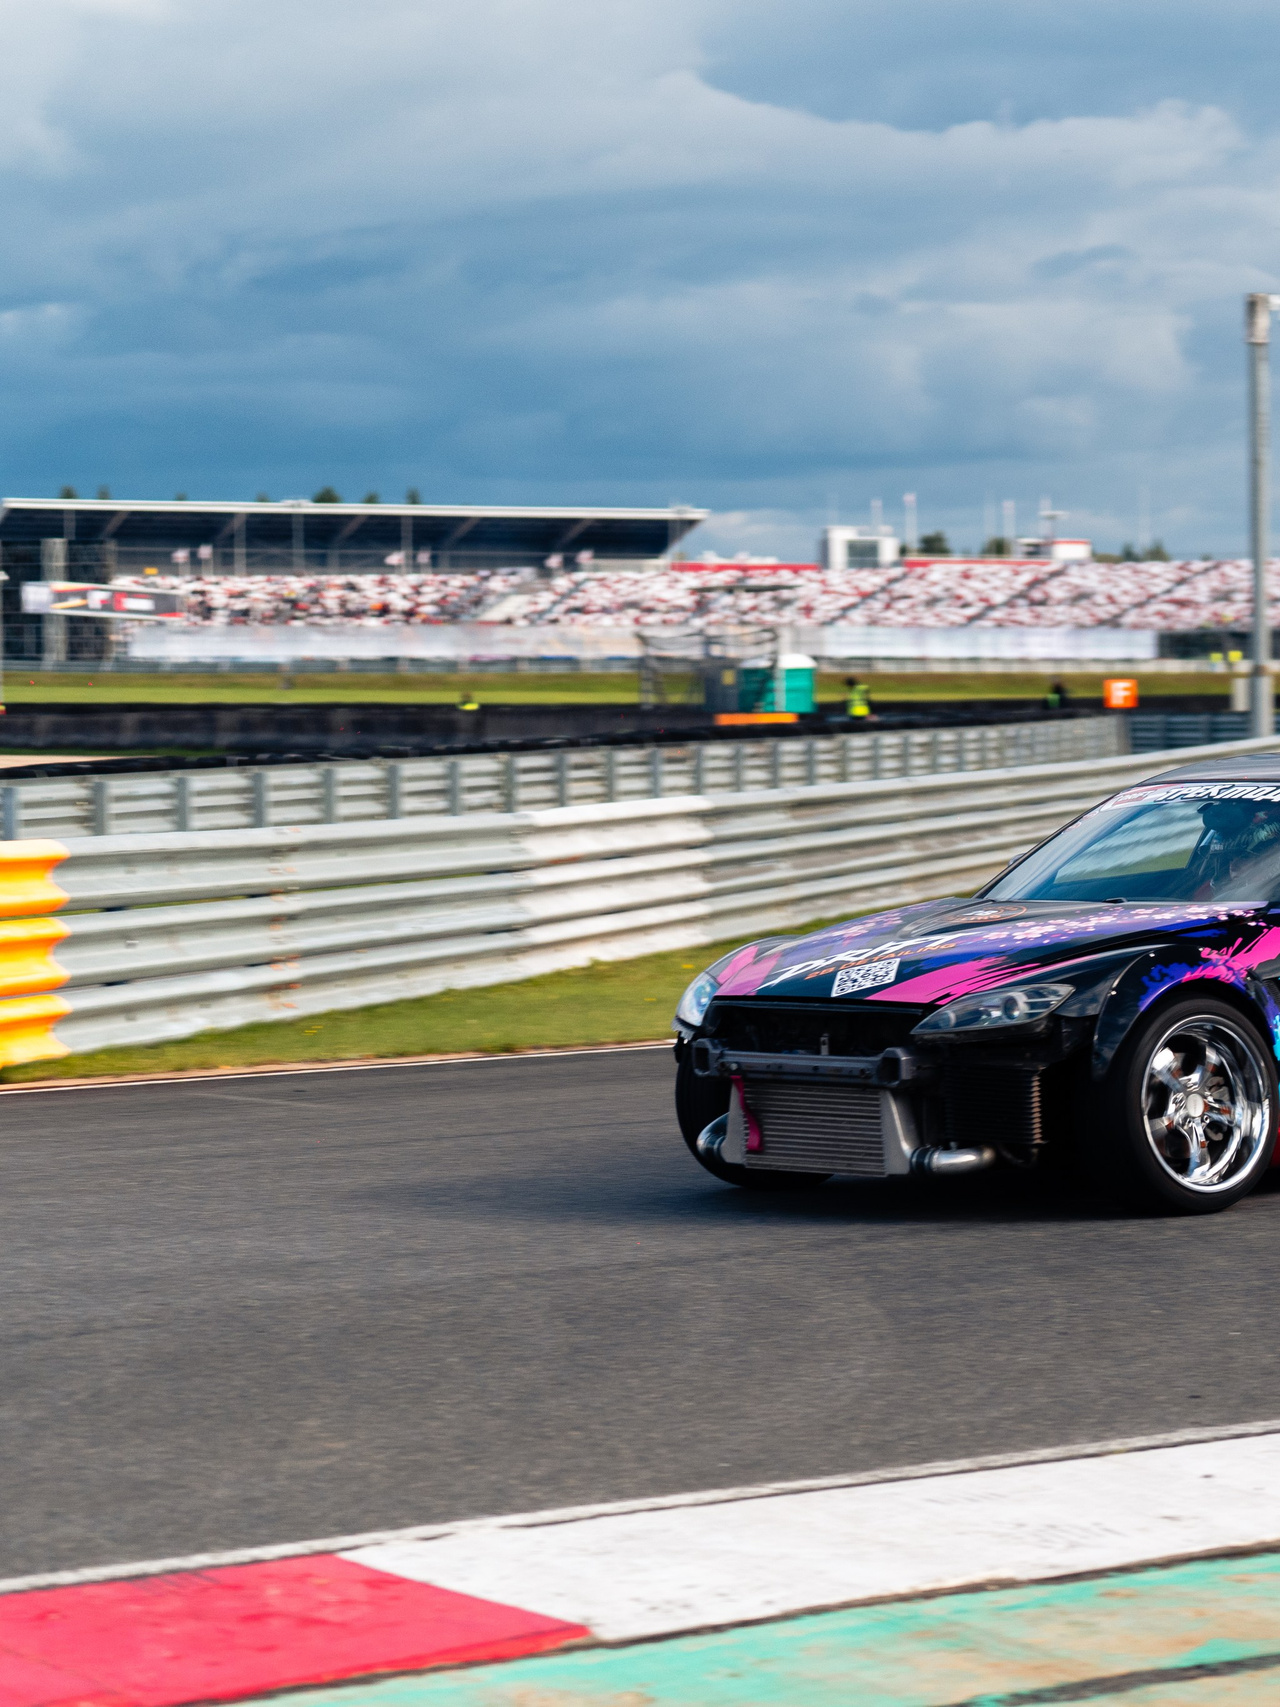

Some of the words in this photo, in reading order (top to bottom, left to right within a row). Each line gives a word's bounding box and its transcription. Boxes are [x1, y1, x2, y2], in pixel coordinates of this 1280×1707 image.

[1111, 682, 1131, 705] F
[752, 931, 980, 992] DRIFT
[804, 967, 834, 980] 2B
[839, 944, 956, 970] DETAILING
